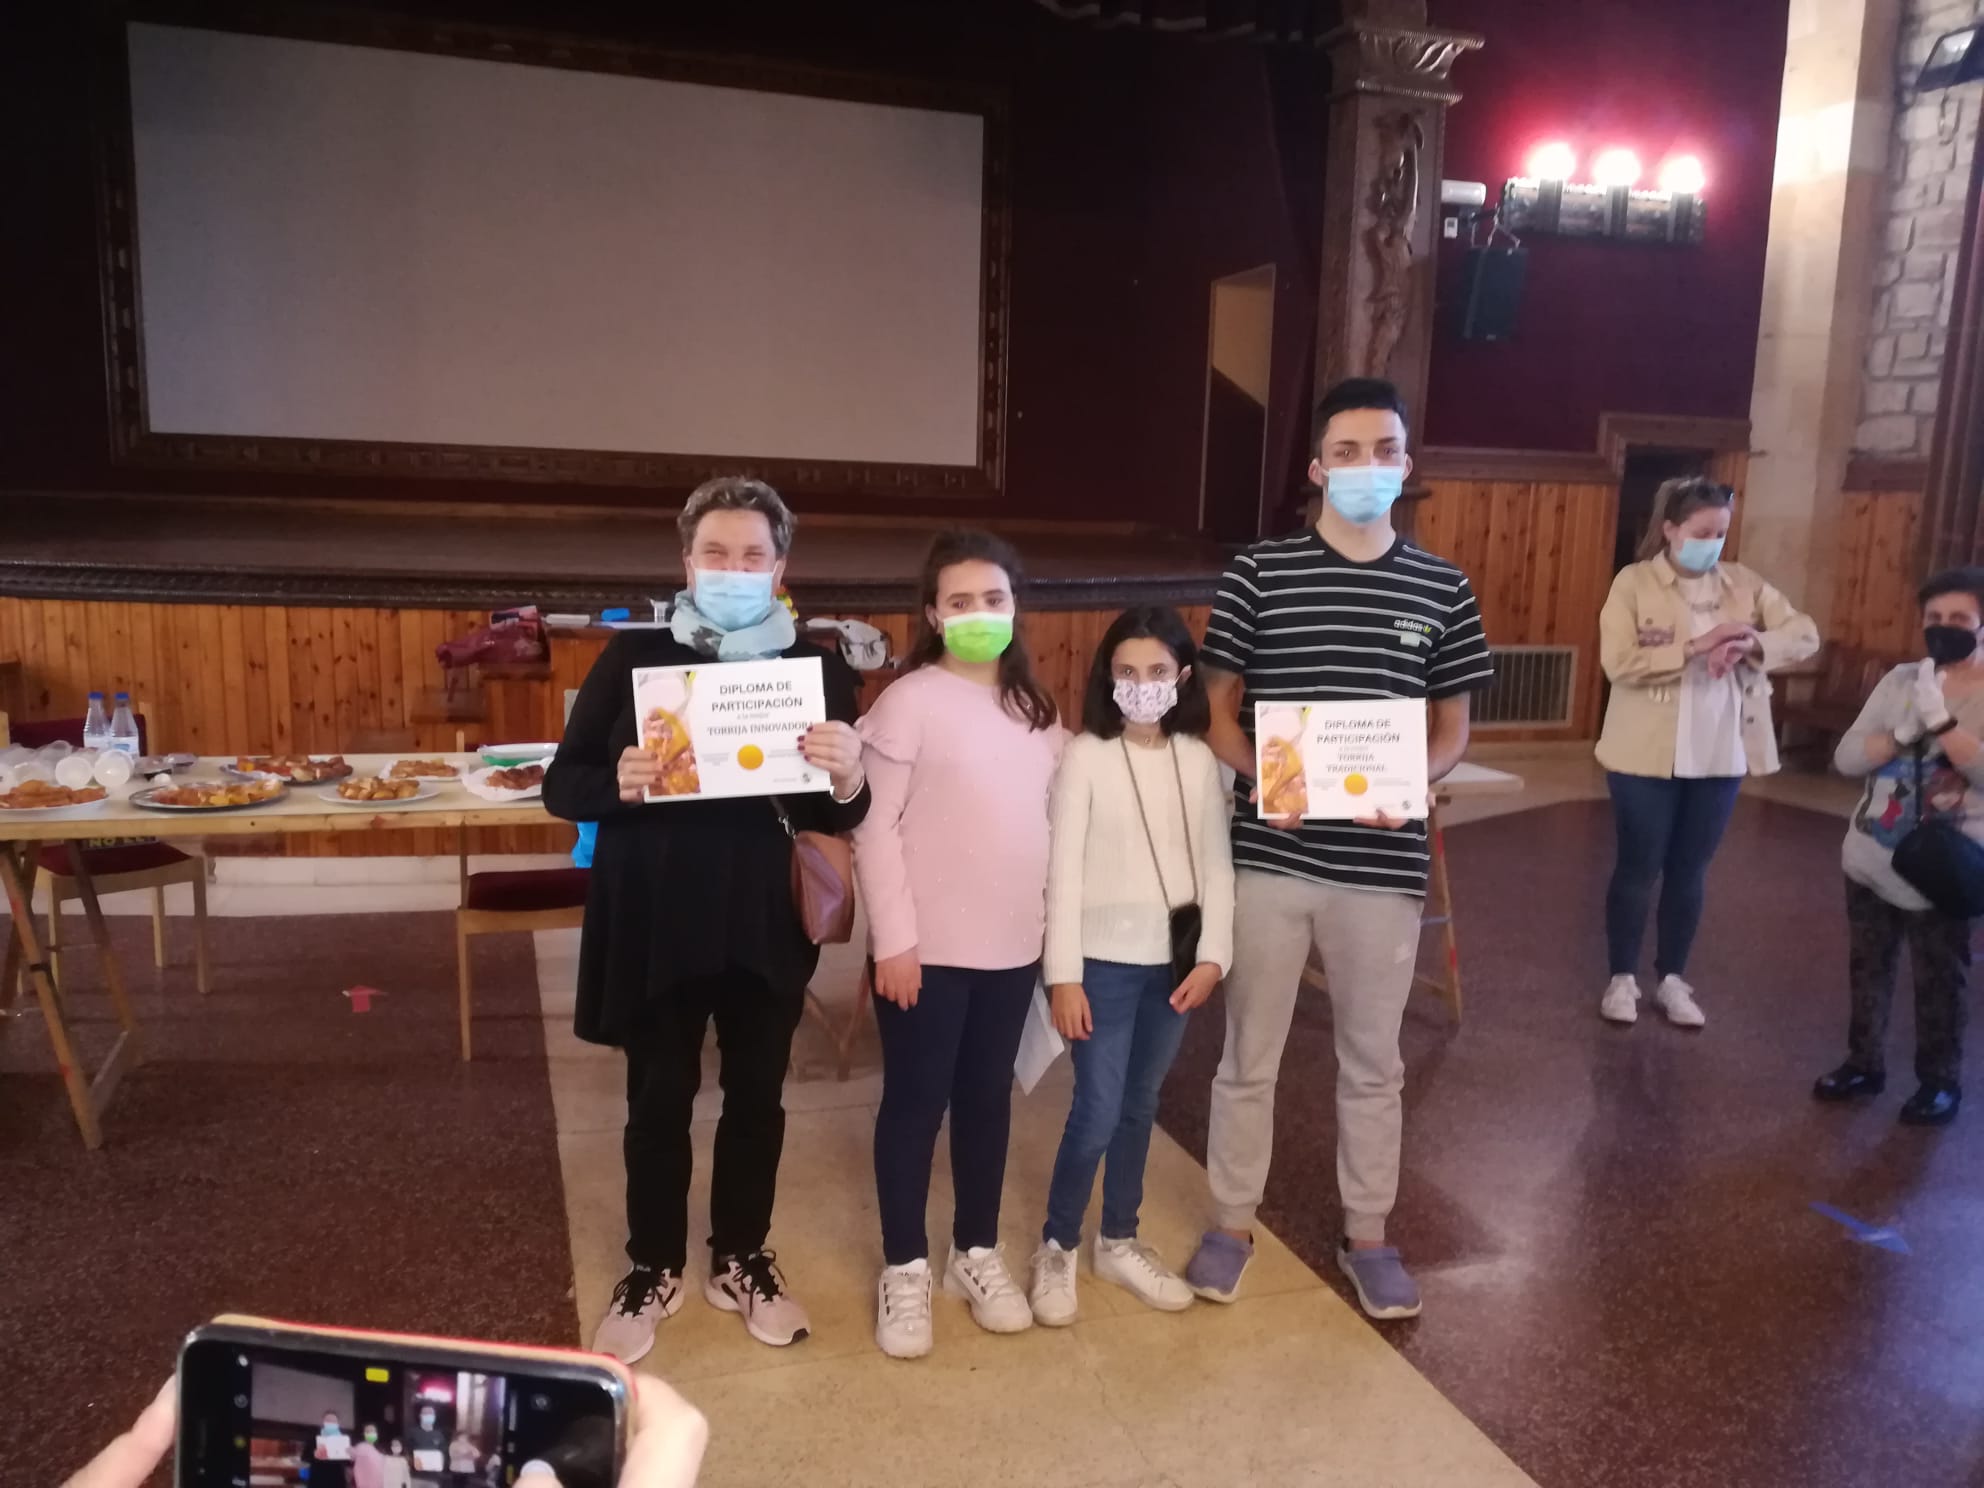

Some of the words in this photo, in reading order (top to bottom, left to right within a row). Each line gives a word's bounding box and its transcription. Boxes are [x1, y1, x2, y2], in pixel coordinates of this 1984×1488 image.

[1394, 619, 1423, 632] adidas
[719, 681, 774, 695] DIPLOMA
[776, 680, 792, 691] DE
[711, 696, 803, 712] PARTICIPACIÓN
[708, 725, 748, 735] TORRIJA
[1324, 719, 1373, 730] DIPLOMA
[1376, 718, 1391, 729] DE
[1316, 732, 1400, 744] PARTICIPACIÓN
